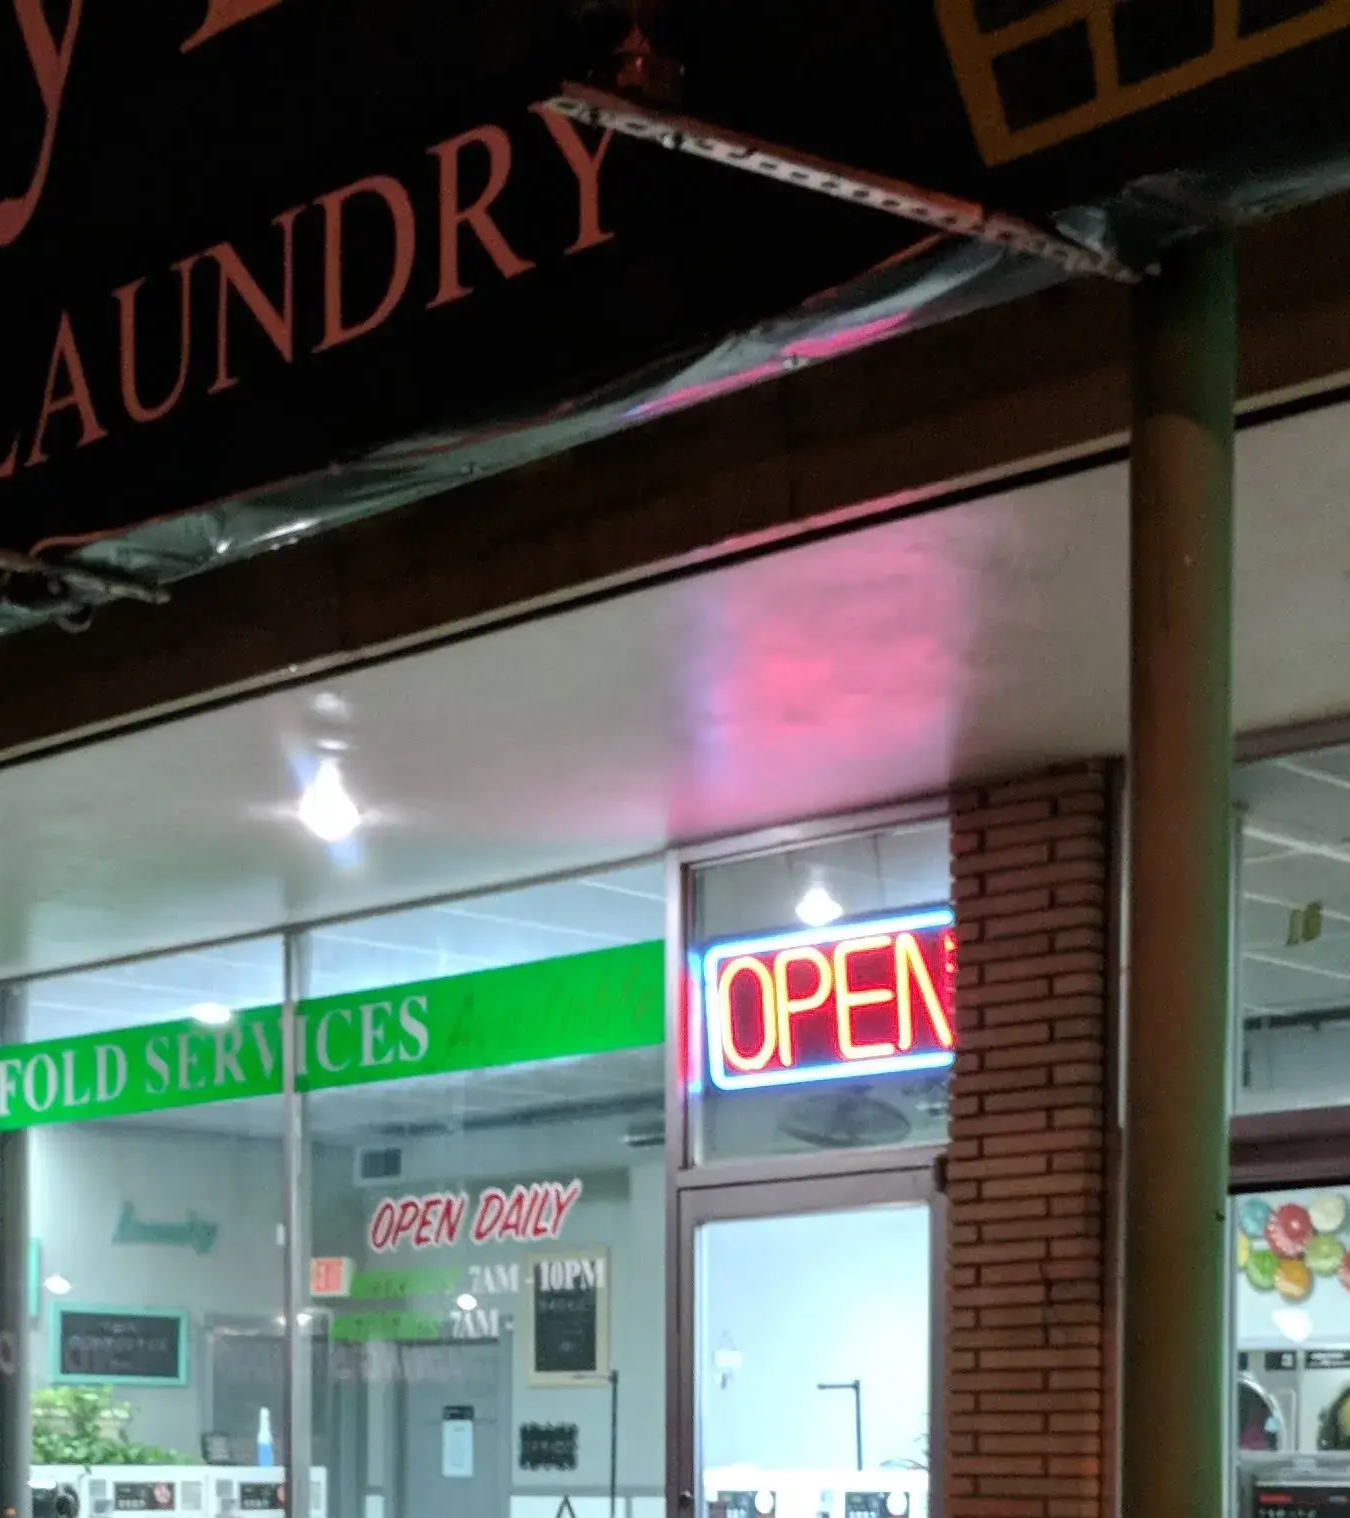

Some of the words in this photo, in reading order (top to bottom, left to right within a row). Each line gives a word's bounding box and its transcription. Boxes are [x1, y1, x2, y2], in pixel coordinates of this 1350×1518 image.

[718, 932, 954, 1072] OPEN
[145, 995, 430, 1094] SERVICES
[369, 1193, 468, 1254] OPEN
[471, 1178, 582, 1247] DAILY
[468, 1263, 520, 1294] 7AM
[537, 1257, 606, 1292] 10PM
[449, 1308, 499, 1339] 7AM
